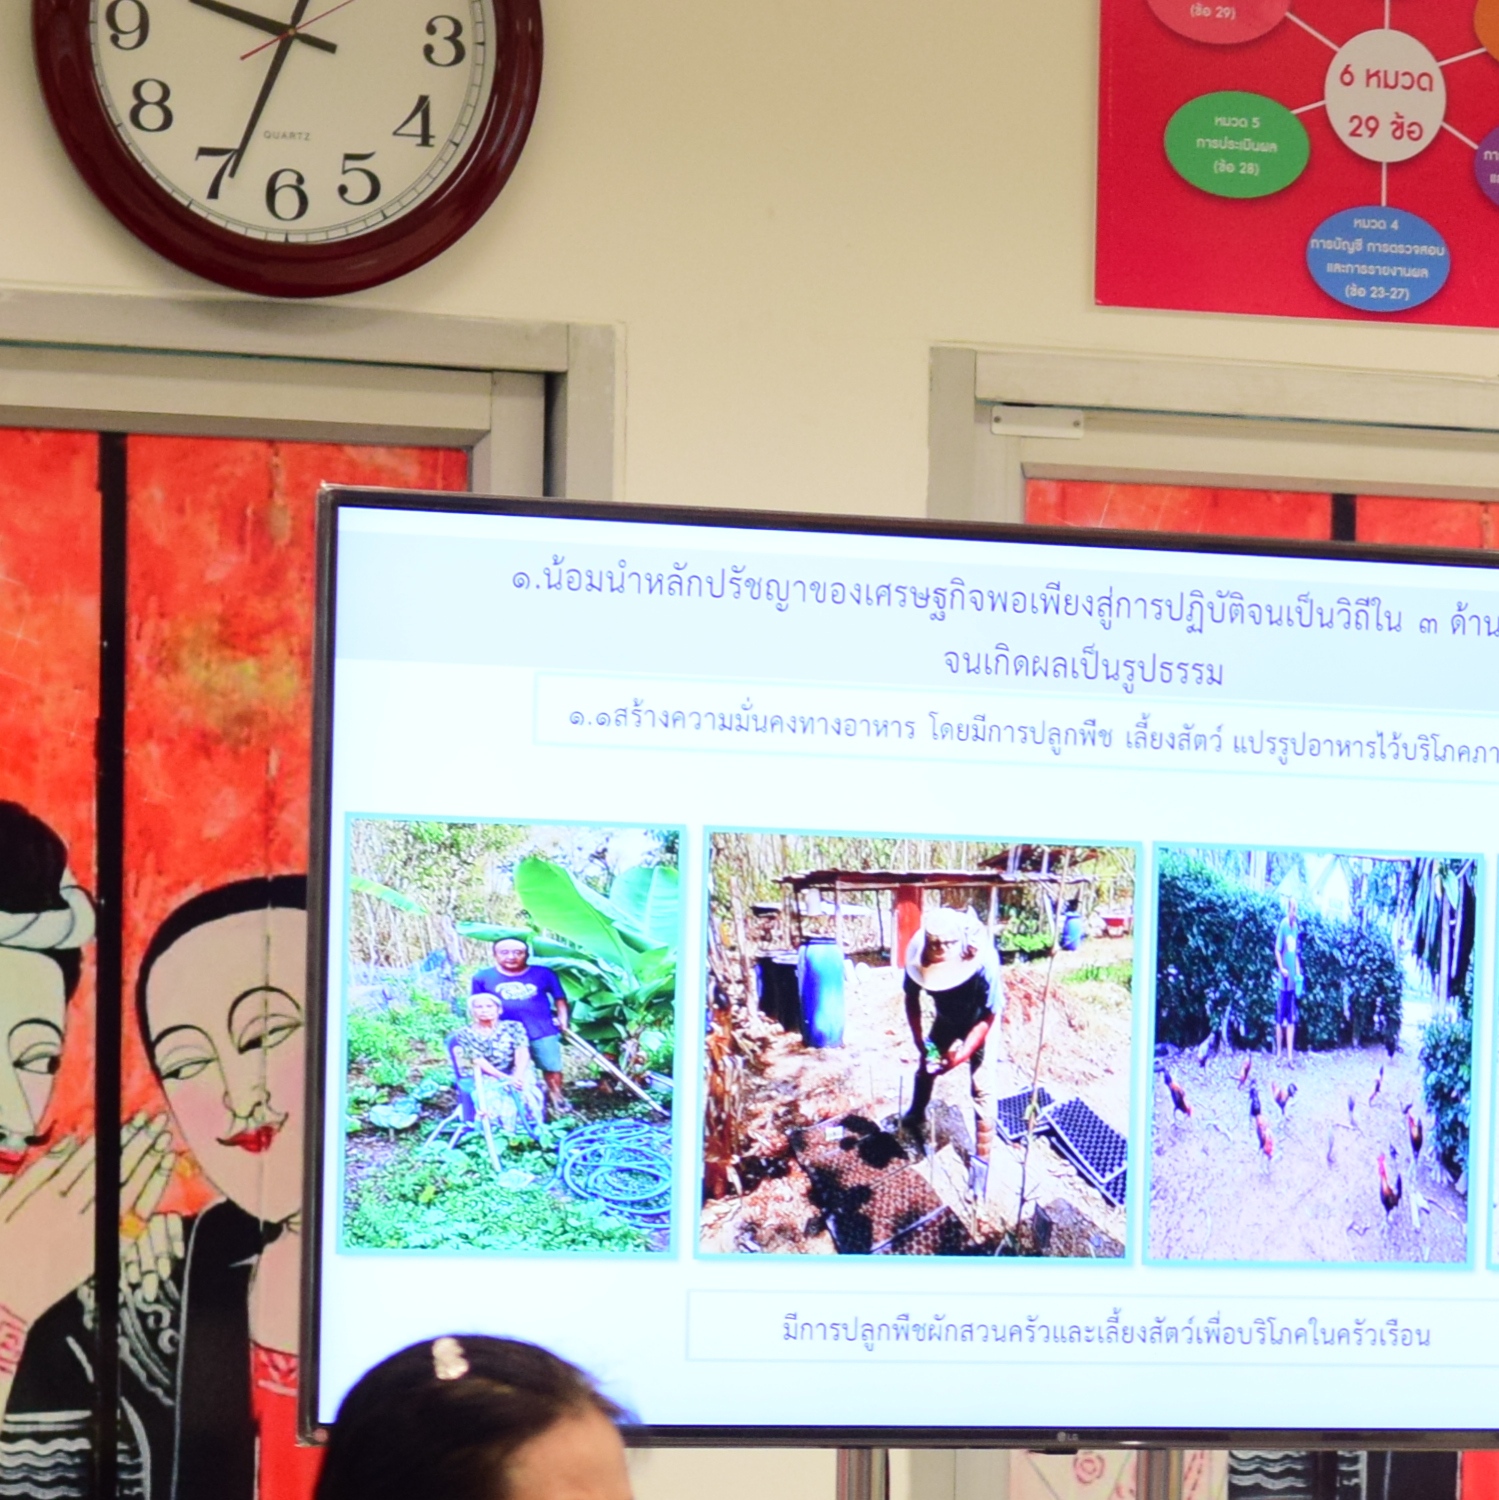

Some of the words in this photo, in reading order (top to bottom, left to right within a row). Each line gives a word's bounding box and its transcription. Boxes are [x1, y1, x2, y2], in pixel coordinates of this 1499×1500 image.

[105, 0, 150, 50] 9
[1215, 6, 1236, 20] 29)
[423, 15, 466, 67] 3
[1339, 64, 1354, 87] 6
[1365, 67, 1434, 92] หมวด
[129, 78, 173, 132] 8
[391, 95, 435, 147] 4
[1215, 115, 1248, 128] หมวด
[1251, 117, 1261, 128] 5
[1348, 114, 1379, 138] 29
[1390, 112, 1423, 142] ข้อ
[263, 130, 312, 141] QUARTZ
[1196, 135, 1277, 153] การประเมินผล
[195, 147, 241, 199] 7
[337, 151, 381, 205] 5
[1238, 162, 1260, 176] 28)
[265, 168, 309, 221] 6
[1353, 218, 1387, 230] หมวด
[1390, 219, 1399, 231] 4
[1310, 237, 1364, 254] การบัญชี
[1367, 241, 1446, 257] การตรวจสอบ
[1326, 262, 1429, 278] และการรายงานผล
[1370, 286, 1410, 301] 23-27)
[1418, 614, 1438, 635] ๓
[944, 642, 1224, 695] จนเกิดผลเป็นรูปธรรม
[927, 710, 1114, 756] โดยมีการปลูกพืช
[1125, 712, 1223, 754] เลี้ยงสัตว์
